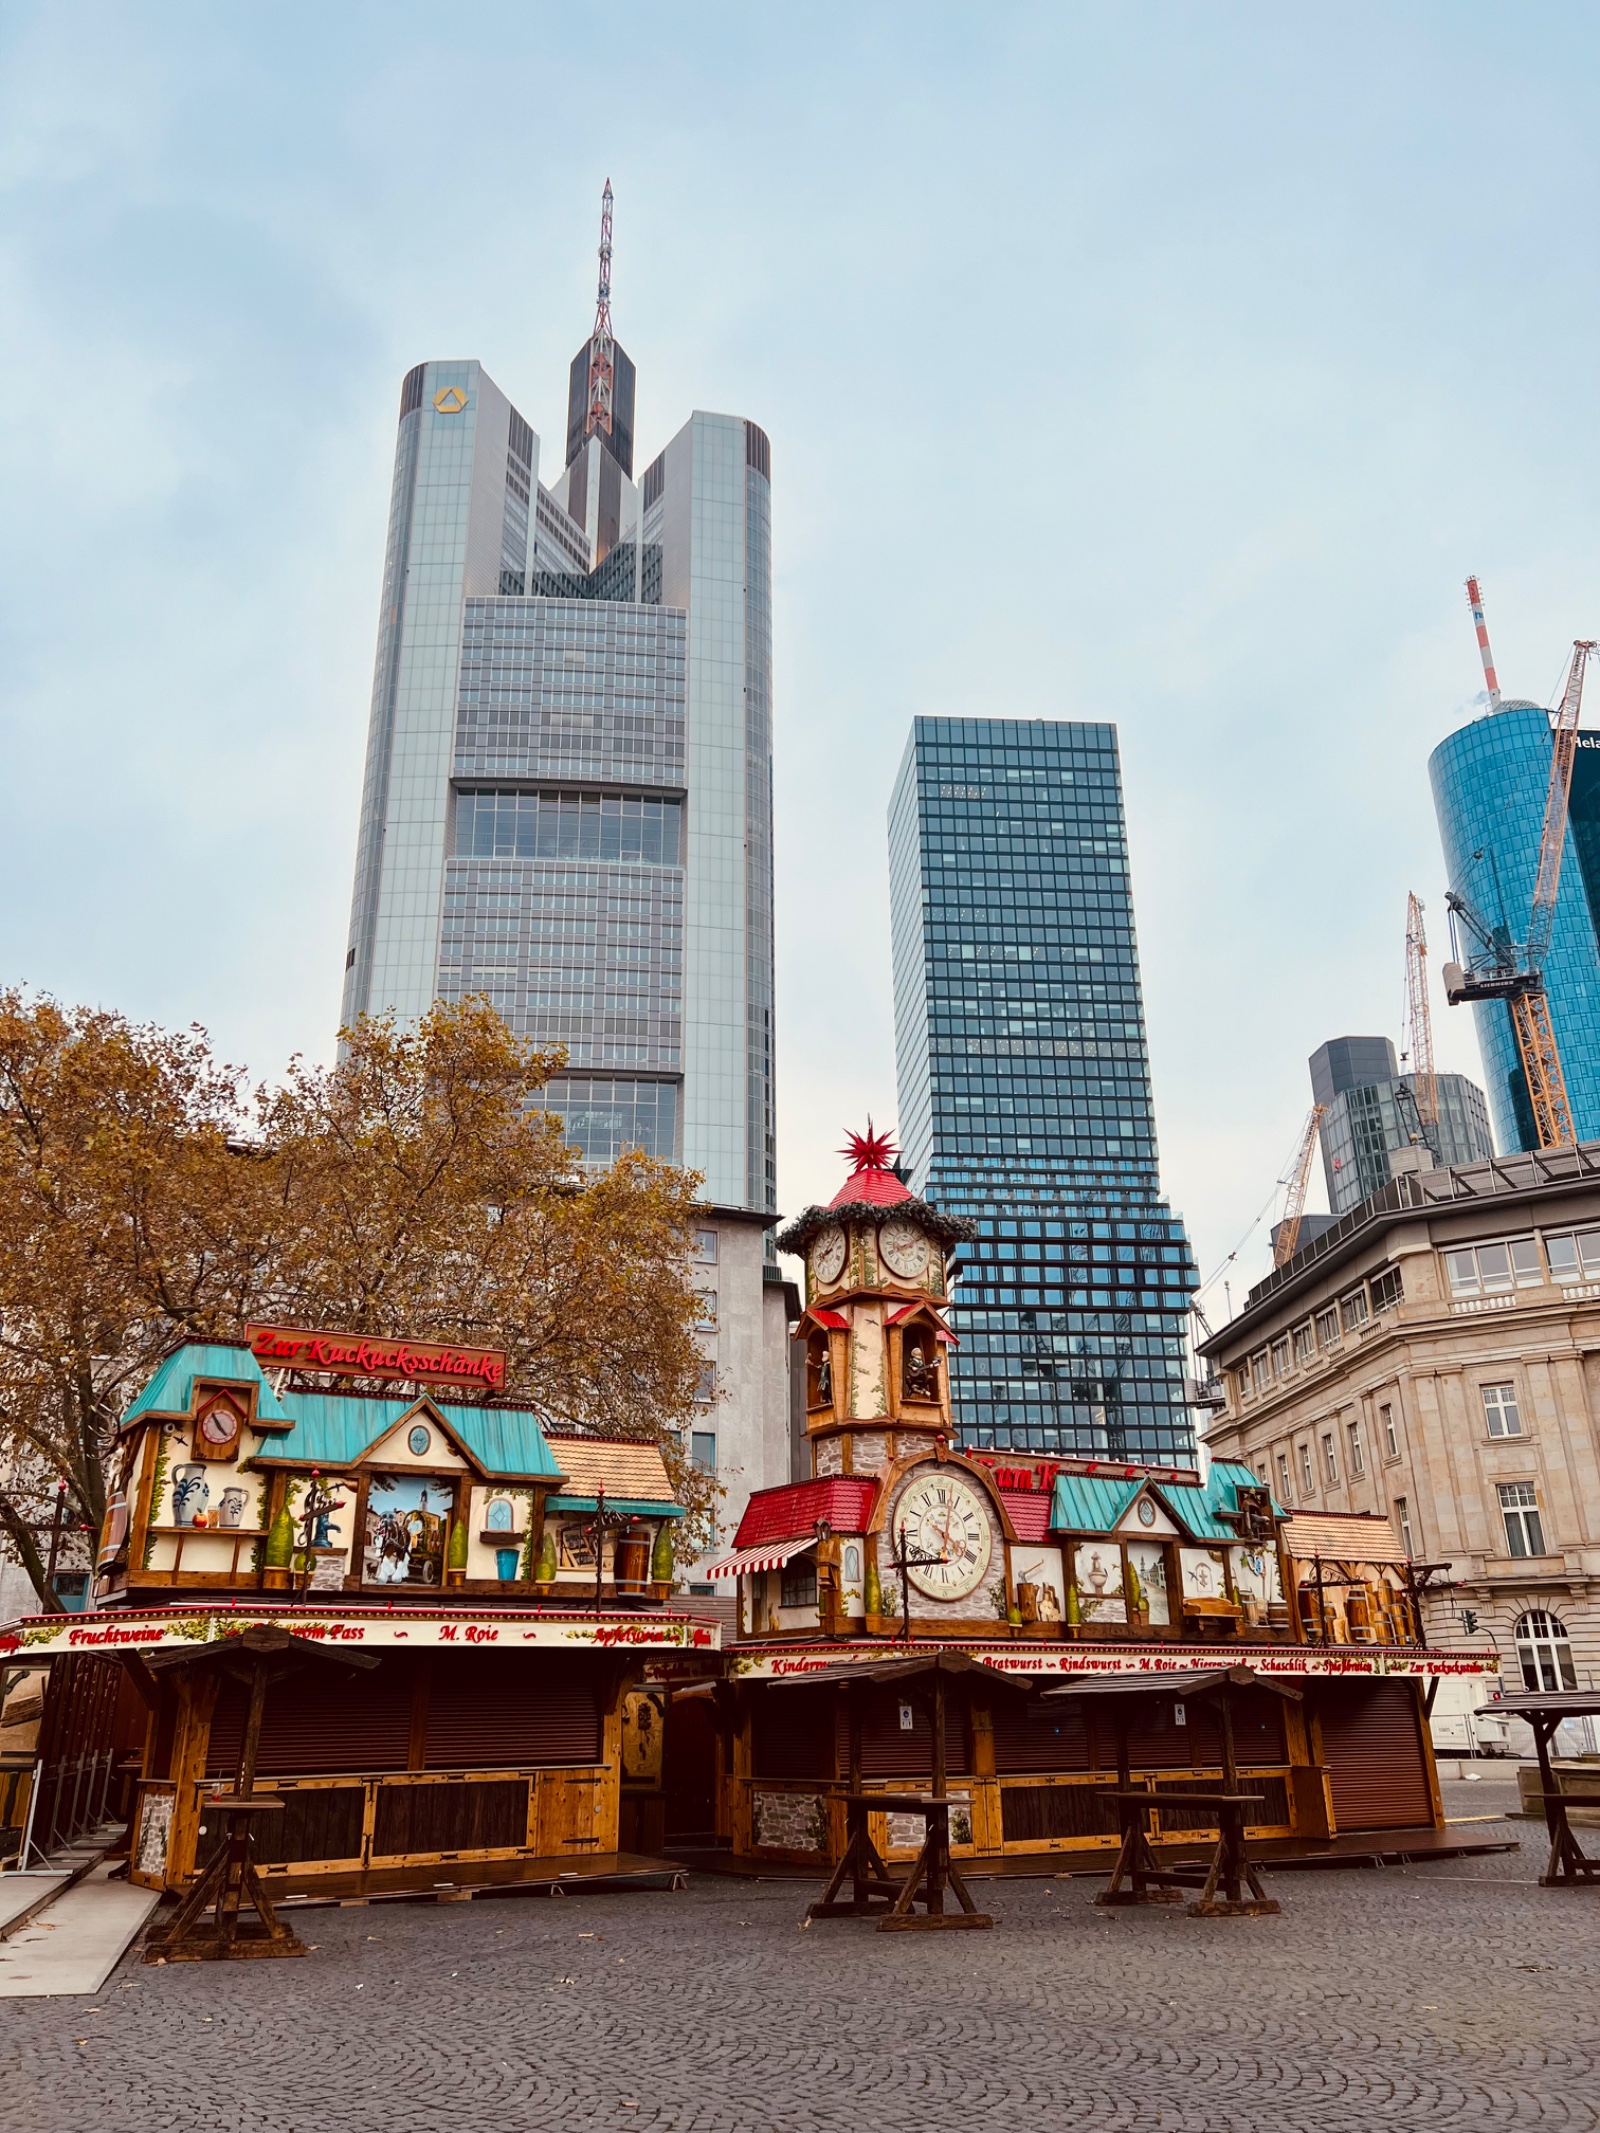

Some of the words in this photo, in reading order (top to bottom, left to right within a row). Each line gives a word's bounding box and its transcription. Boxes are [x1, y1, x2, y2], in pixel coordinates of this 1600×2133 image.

[252, 1331, 304, 1357] Zur
[306, 1338, 503, 1385] Kuckucksschänke
[68, 1624, 164, 1646] Fruchtweine
[983, 1656, 1043, 1669] Bratwurst
[1059, 1656, 1122, 1672] Rindswurst
[1260, 1658, 1310, 1674] Schaschlik
[1410, 1661, 1425, 1673] Zur
